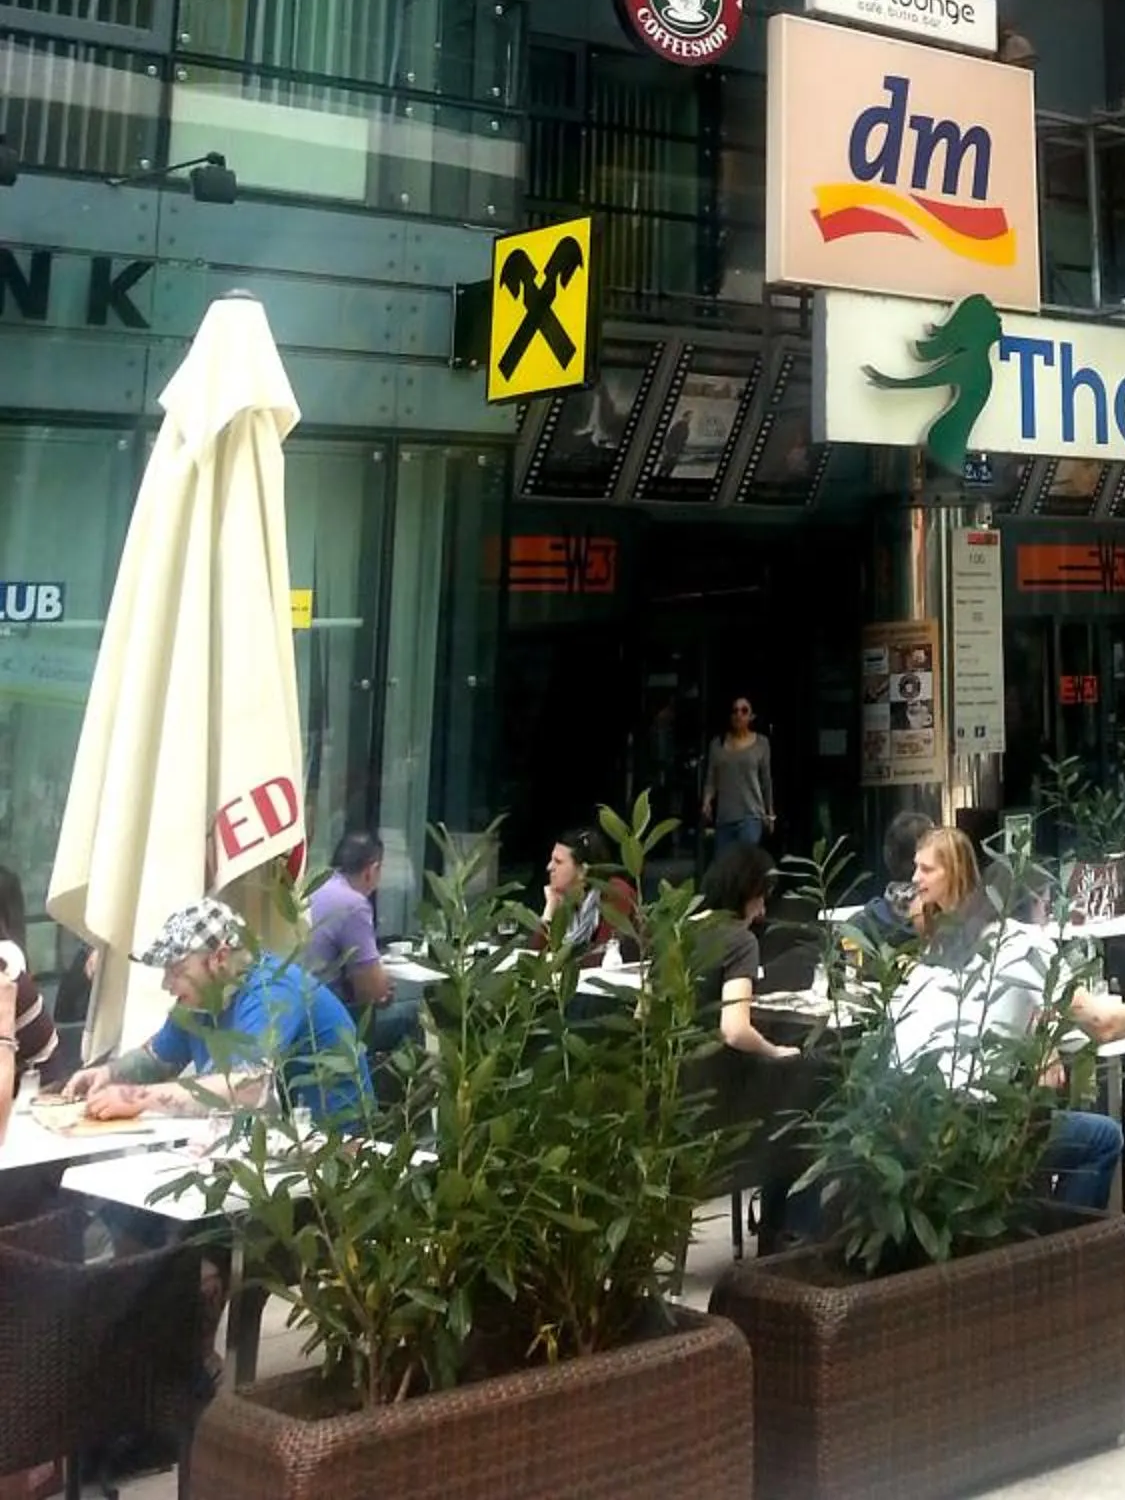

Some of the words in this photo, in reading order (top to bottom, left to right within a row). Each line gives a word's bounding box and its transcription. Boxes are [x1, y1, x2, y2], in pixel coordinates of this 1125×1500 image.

[637, 7, 729, 57] COFFEESHOP
[847, 75, 993, 200] dm
[0, 584, 63, 621] UB
